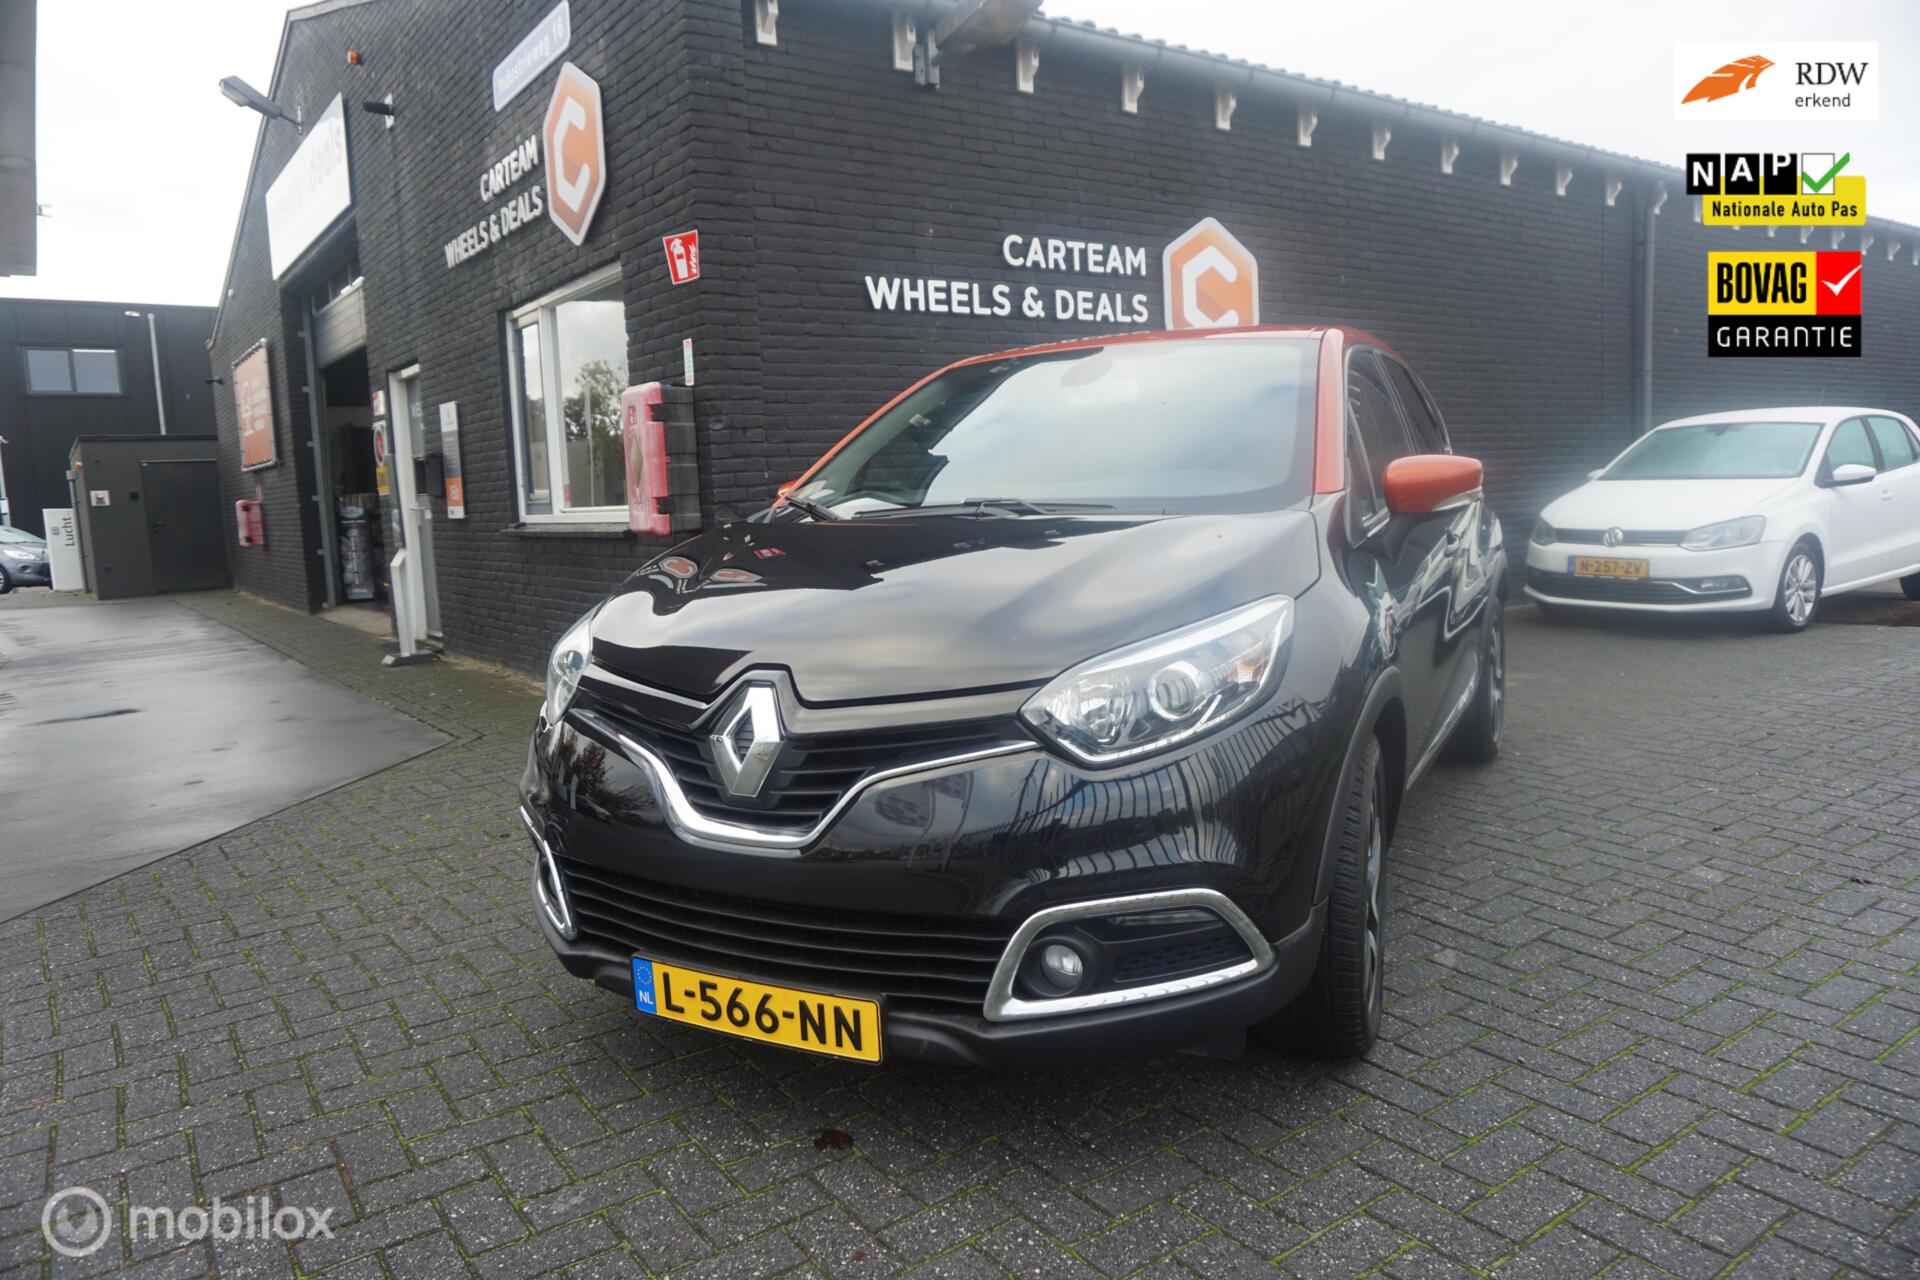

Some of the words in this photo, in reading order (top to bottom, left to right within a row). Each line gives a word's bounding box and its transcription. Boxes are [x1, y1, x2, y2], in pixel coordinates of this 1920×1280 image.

[552, 16, 564, 41] 16
[480, 134, 539, 203] CARTEAM
[445, 220, 490, 268] WHEELS
[489, 214, 501, 243] &
[500, 185, 544, 236] DEALS
[1002, 234, 1147, 276] CARTEAM
[865, 276, 1011, 316] WHEELS
[1022, 287, 1046, 318] &
[1055, 289, 1149, 323] DEALS
[61, 516, 76, 547] Lucht
[1579, 560, 1643, 574] N-257-ZV
[639, 990, 654, 1005] NL
[662, 971, 863, 1052] L-566-NN
